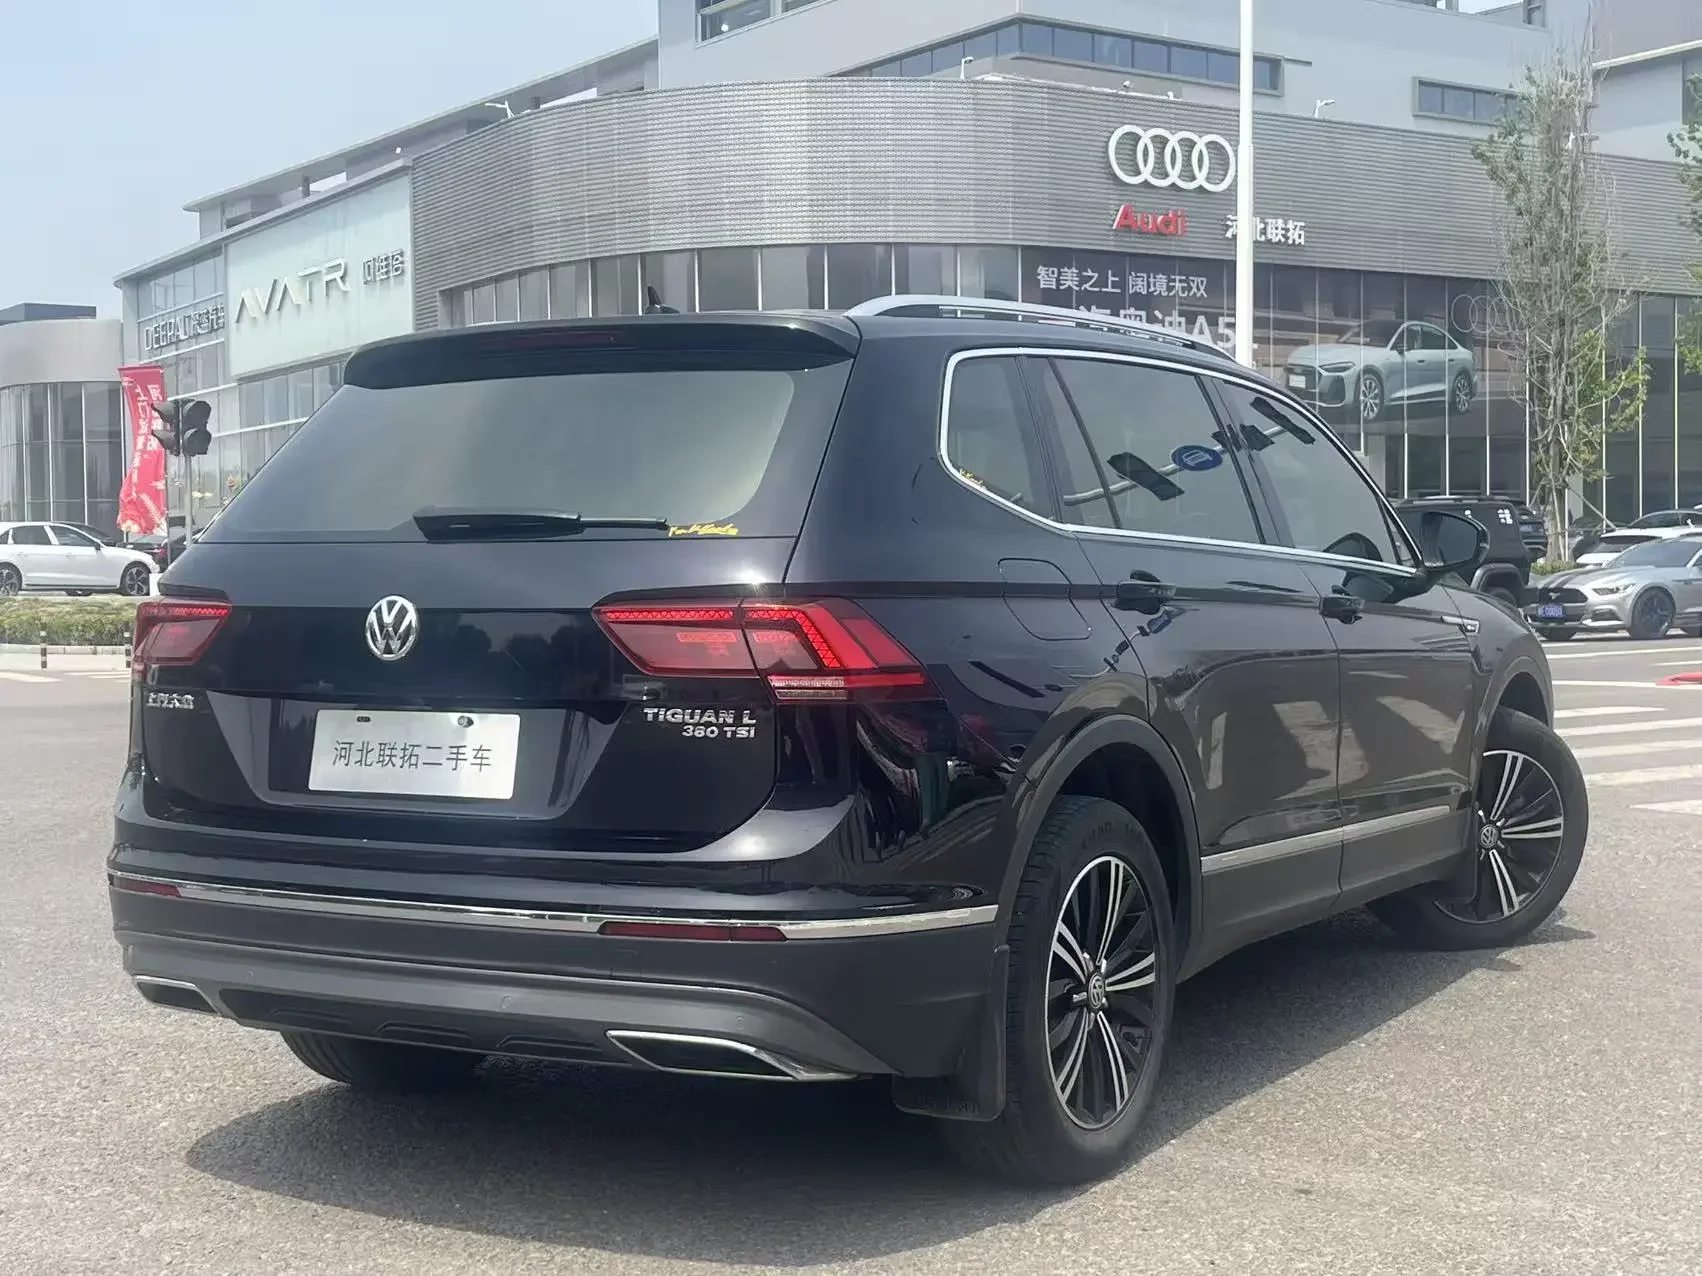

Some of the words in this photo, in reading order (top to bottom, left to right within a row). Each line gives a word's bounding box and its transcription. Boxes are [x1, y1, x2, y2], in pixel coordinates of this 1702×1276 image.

[1112, 203, 1187, 236] Audi
[235, 258, 350, 323] AVATR
[1036, 265, 1122, 293] 智美之上
[1128, 271, 1208, 298] 阔境无双
[723, 726, 756, 739] TSI
[742, 710, 757, 724] L
[332, 740, 493, 773] 河北联拓二手车
